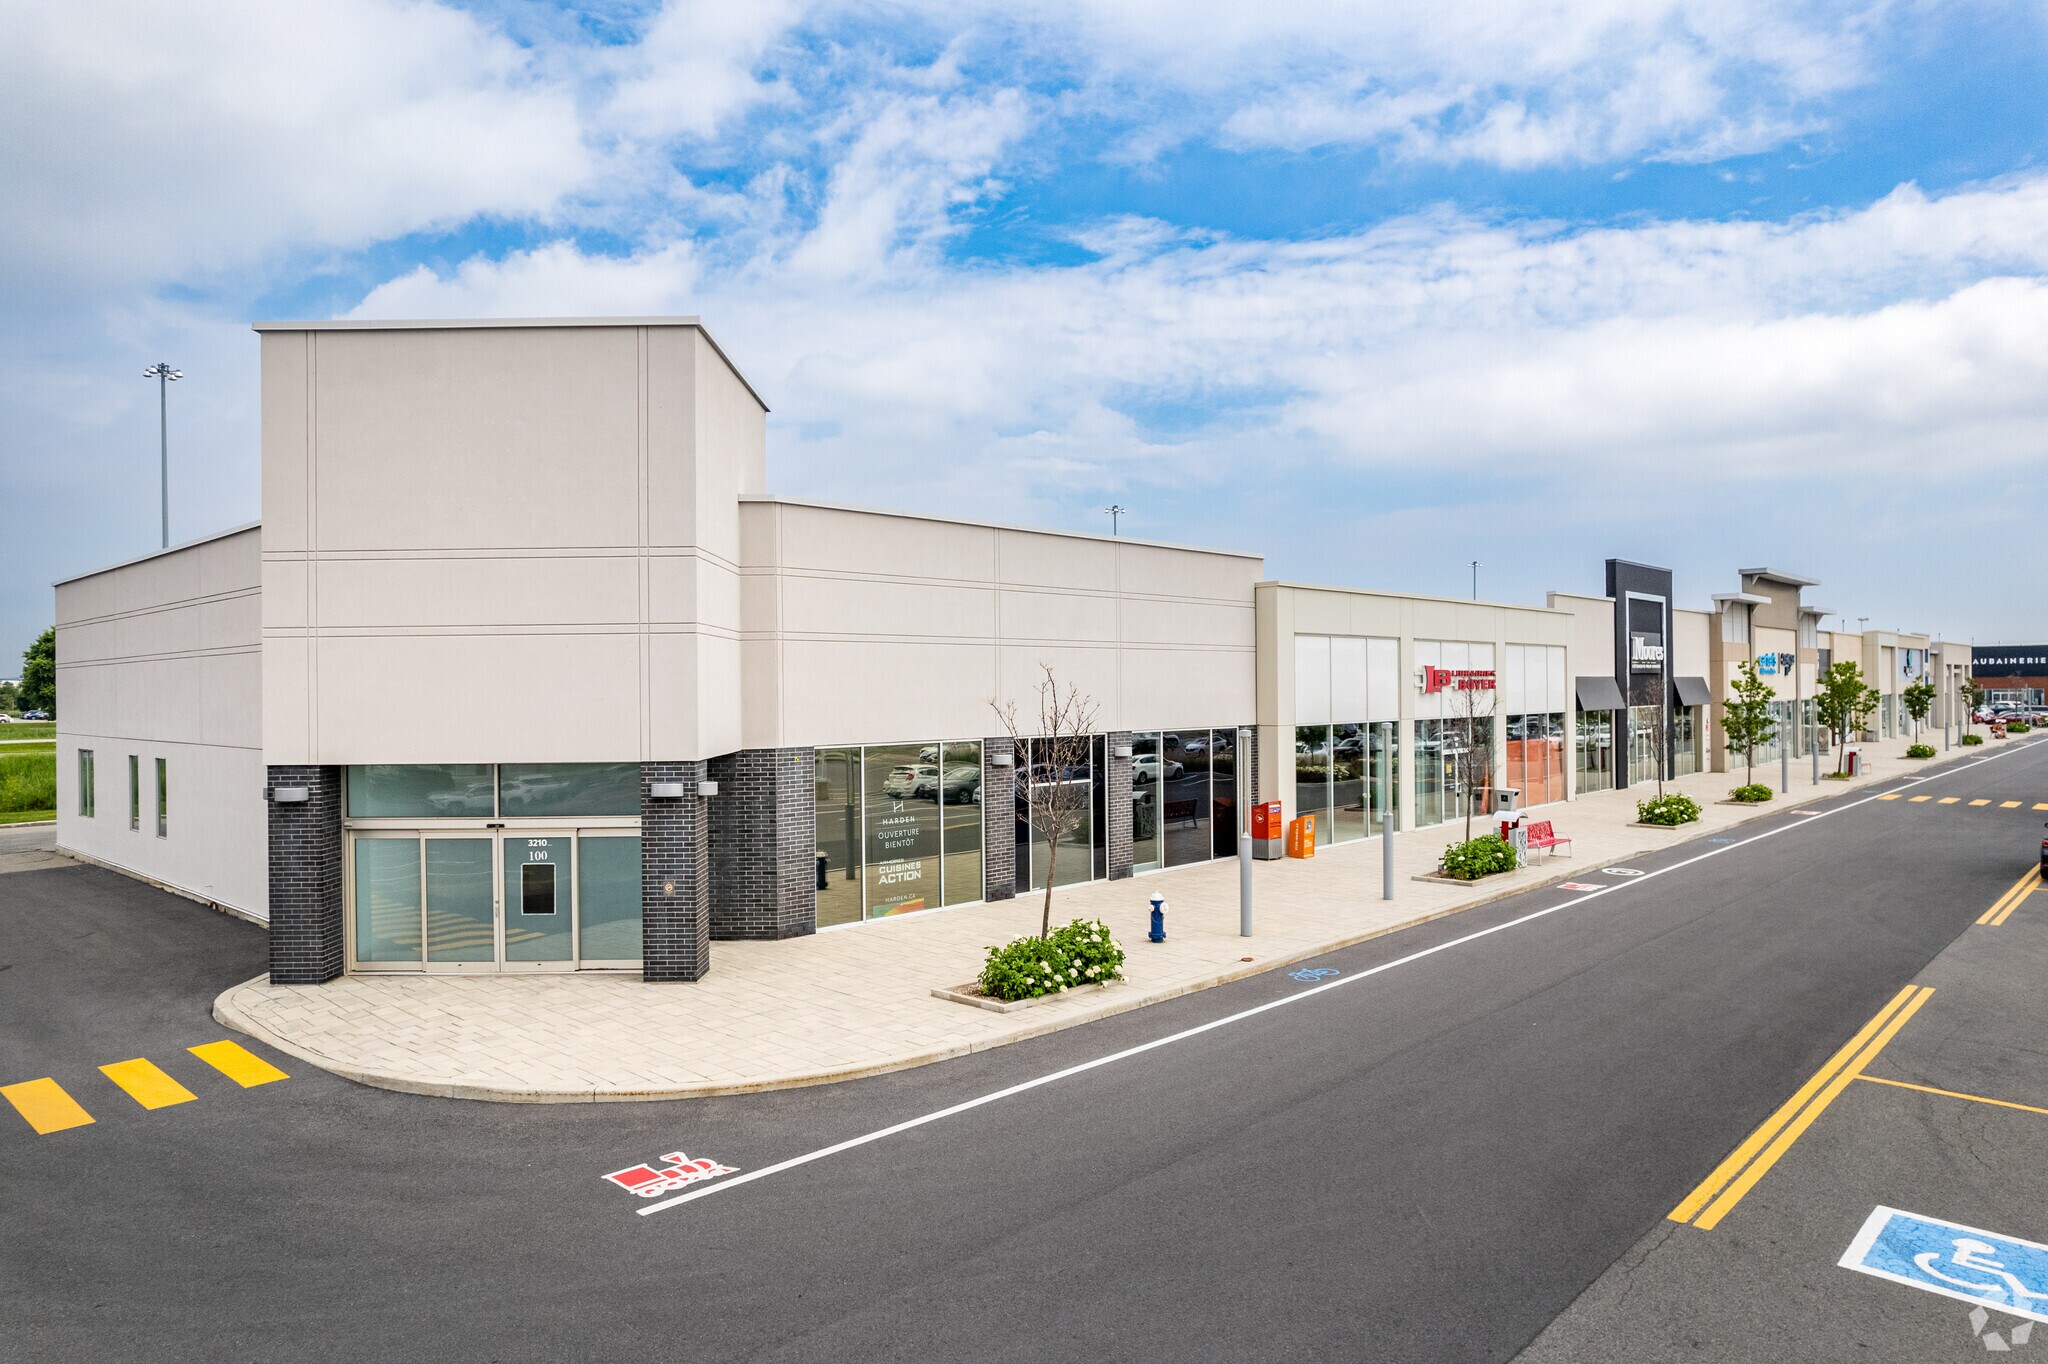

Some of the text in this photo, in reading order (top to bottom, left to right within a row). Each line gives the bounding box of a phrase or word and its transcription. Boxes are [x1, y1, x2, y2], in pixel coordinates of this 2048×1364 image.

[1631, 636, 1664, 661] Moores
[1972, 657, 2047, 665] AUBAINERIE
[1458, 679, 1496, 690] BOYER
[882, 816, 915, 825] HARDEN
[878, 828, 919, 839] OUVERTURE
[527, 839, 547, 847] 3210
[884, 837, 915, 849] BIENTÔT
[529, 850, 548, 861] 100
[879, 861, 921, 874] CUISINES
[878, 870, 921, 885] ACTION
